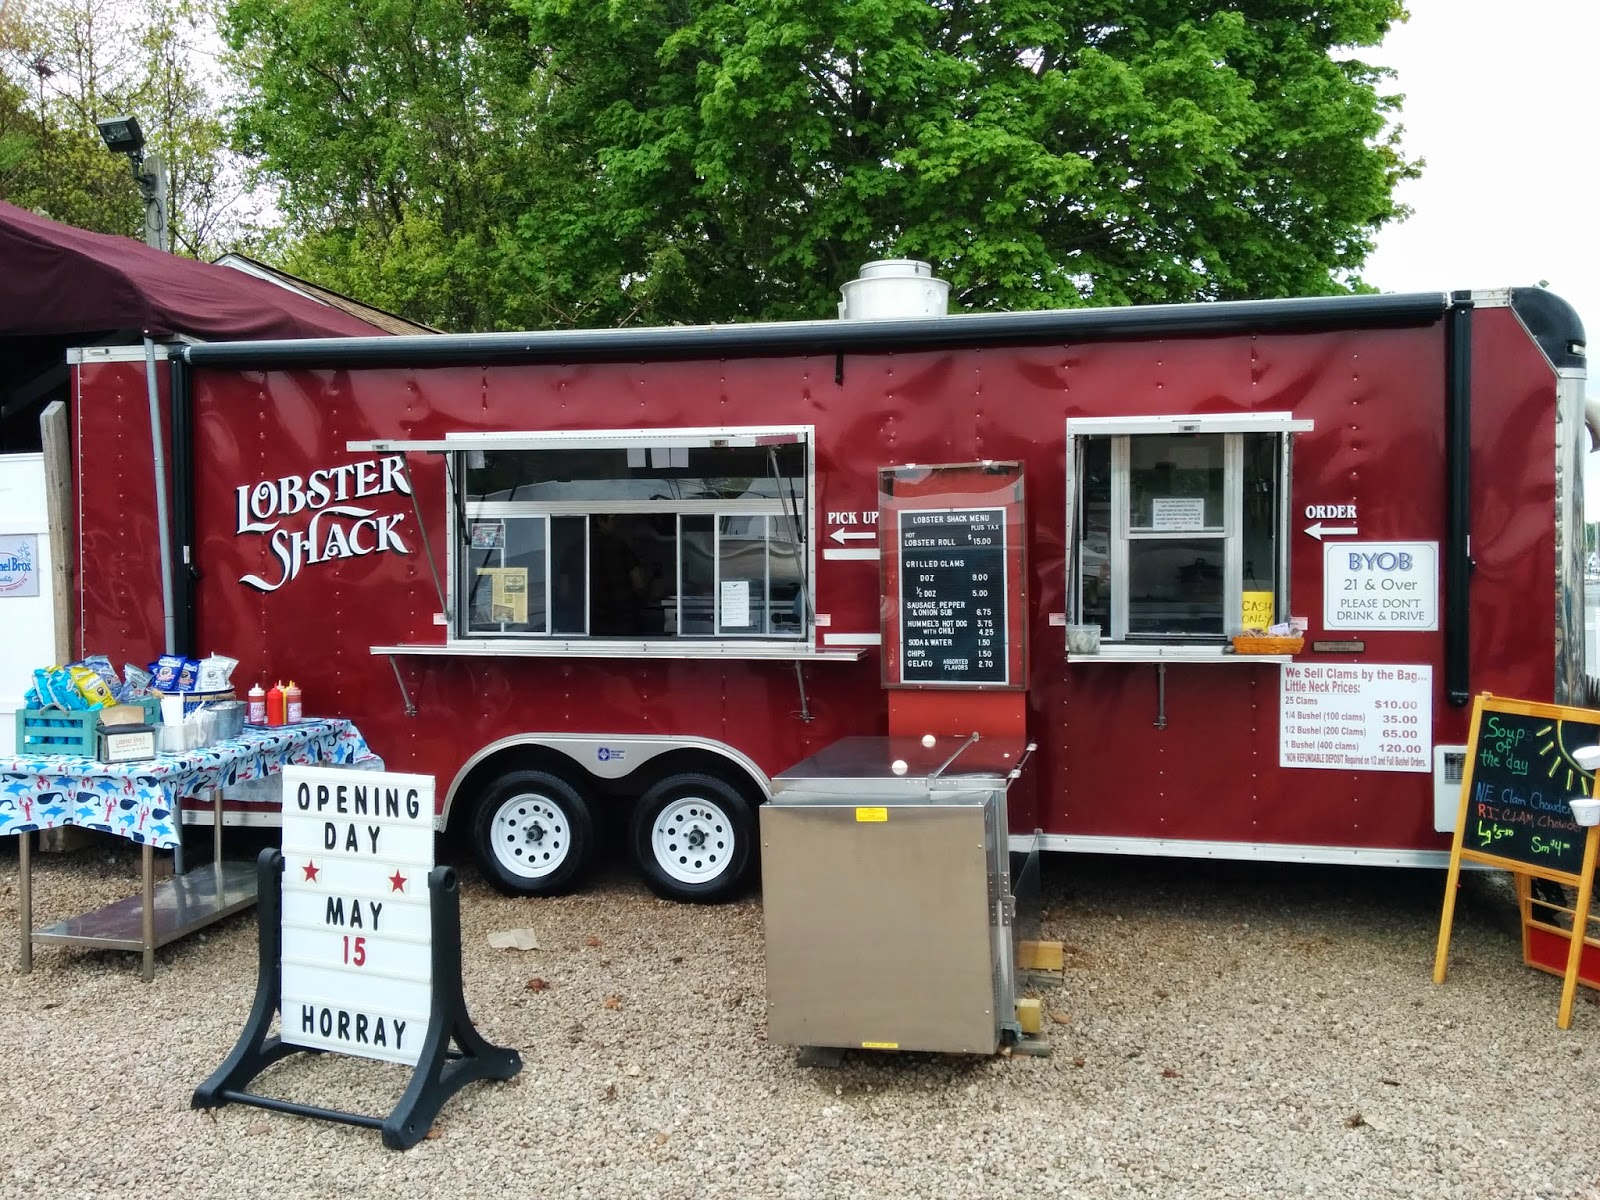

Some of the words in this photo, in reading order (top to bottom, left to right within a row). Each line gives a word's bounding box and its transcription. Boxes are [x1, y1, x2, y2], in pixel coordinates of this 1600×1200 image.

[236, 456, 411, 534] LOBSTER
[827, 511, 857, 524] PICK
[862, 511, 879, 524] UP
[1305, 505, 1357, 519] ORDER
[913, 516, 944, 524] LOBSTER
[946, 515, 967, 523] SHACK
[969, 514, 990, 522] MENU
[238, 505, 410, 591] SHACK
[904, 539, 935, 547] LOBSTER
[938, 538, 956, 546] ROLL
[905, 560, 938, 568] GRILLED
[940, 559, 965, 567] CLAMS
[1348, 552, 1412, 571] BYOB
[920, 574, 935, 582] DOZ
[972, 573, 988, 581] 9.00
[1343, 579, 1358, 591] 21
[1364, 579, 1376, 590] &
[1381, 579, 1418, 590] Over
[972, 589, 988, 597] 5.00
[939, 601, 966, 609] PEPPER
[1242, 600, 1272, 612] CASH
[1340, 598, 1378, 609] PLEASE
[1382, 598, 1421, 608] DON'T
[976, 608, 992, 616] 6.75
[1336, 611, 1374, 621] DRINK
[1377, 611, 1387, 621] &
[1390, 611, 1425, 620] DRIVE
[1242, 614, 1273, 628] ONLY
[938, 627, 955, 635] CHILI
[978, 628, 994, 636] 4.25
[978, 660, 993, 668] 2.70
[1285, 667, 1301, 678] We
[1304, 667, 1323, 678] Sell
[1326, 668, 1358, 679] Clams
[1361, 669, 1374, 682] by
[1376, 669, 1394, 680] the
[1285, 680, 1306, 692] Little
[1308, 680, 1330, 692] Neck
[1332, 681, 1360, 693] Prices:
[1285, 696, 1294, 704] 25
[1296, 696, 1318, 705] Clams
[1374, 700, 1418, 709] $10.00
[1285, 711, 1295, 719] 1/4
[1297, 711, 1322, 720] Bushel
[1323, 711, 1340, 722] (100
[1341, 712, 1366, 723] clams)
[1382, 715, 1418, 724] 35.00
[1285, 726, 1295, 734] 1/2
[1297, 726, 1322, 735] Bushel
[1323, 726, 1339, 736] (200
[1341, 727, 1367, 738] Clams)
[1382, 729, 1418, 739] 65.00
[1285, 740, 1289, 748] 1
[1291, 740, 1316, 749] Bushel
[1317, 741, 1333, 751] (400
[1334, 742, 1360, 752] clams)
[1379, 744, 1422, 753] 120.00
[1496, 738, 1512, 756] of
[1297, 753, 1325, 763] REFUNDABLE
[1325, 753, 1344, 764] DEPOSIT
[1344, 754, 1363, 766] Required
[1364, 757, 1370, 765] on
[1377, 756, 1386, 766] and
[1395, 756, 1410, 767] Bushel
[1480, 749, 1500, 767] the
[1506, 753, 1528, 775] day
[297, 782, 420, 819] OPENING
[1475, 782, 1494, 802] NE
[1501, 788, 1526, 806] Clam
[1530, 792, 1572, 814] Chowder
[324, 822, 380, 854] DAY
[1478, 820, 1491, 847] Lg
[1531, 836, 1549, 853] Sm
[326, 896, 382, 931] MAY
[343, 935, 366, 967] 15
[302, 1005, 406, 1050] HORRAY
